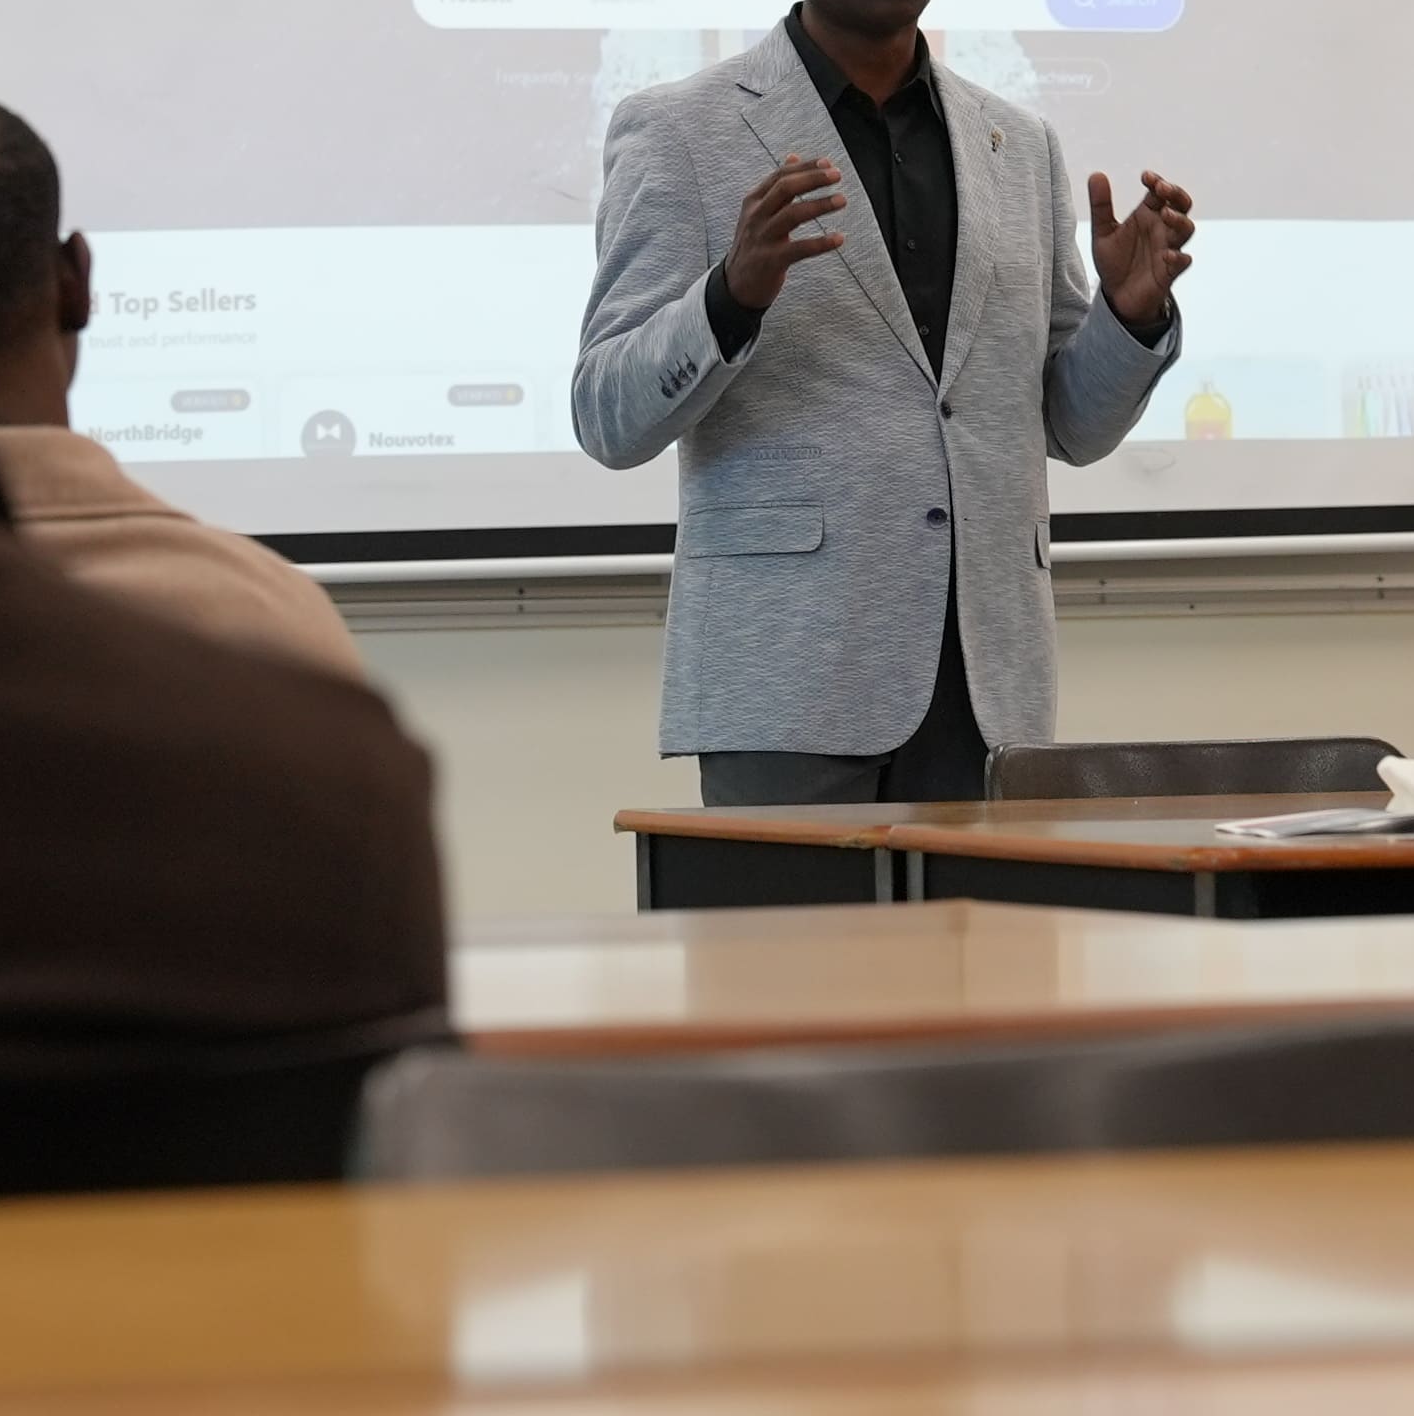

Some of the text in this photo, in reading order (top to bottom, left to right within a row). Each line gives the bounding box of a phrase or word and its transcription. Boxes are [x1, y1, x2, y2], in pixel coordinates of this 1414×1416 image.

[108, 291, 160, 321] Top
[167, 286, 258, 314] Sellers
[127, 332, 157, 348] and
[162, 331, 258, 351] performance
[88, 423, 205, 446] NorthBridge
